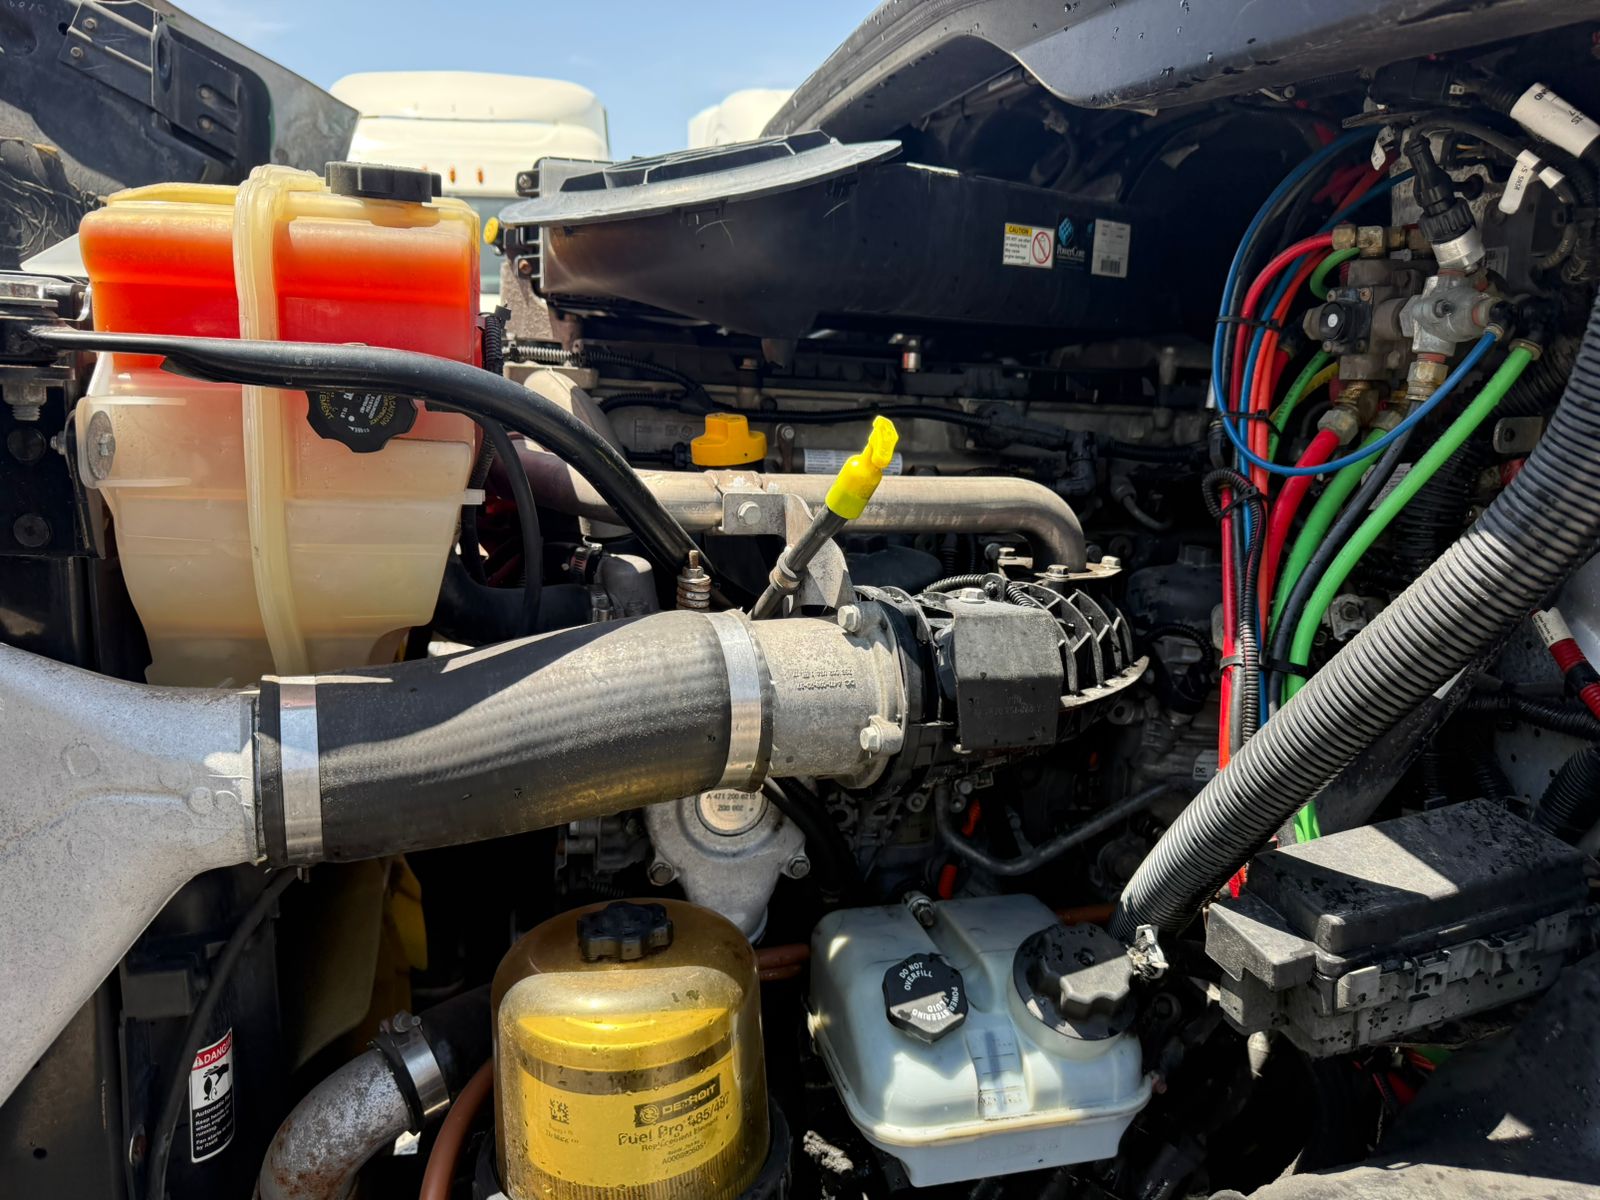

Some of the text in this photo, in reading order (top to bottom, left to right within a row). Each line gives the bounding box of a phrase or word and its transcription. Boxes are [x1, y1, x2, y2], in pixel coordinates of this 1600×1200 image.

[898, 961, 923, 979] DO NOT
[903, 969, 934, 991] OVERFILL
[911, 986, 960, 1022] POWER STEERING
[926, 996, 950, 1014] FLUID
[203, 1036, 232, 1065] DANG
[662, 1083, 717, 1115] DETROIT
[618, 1131, 653, 1147] Fuel
[657, 1123, 684, 1139] Pro
